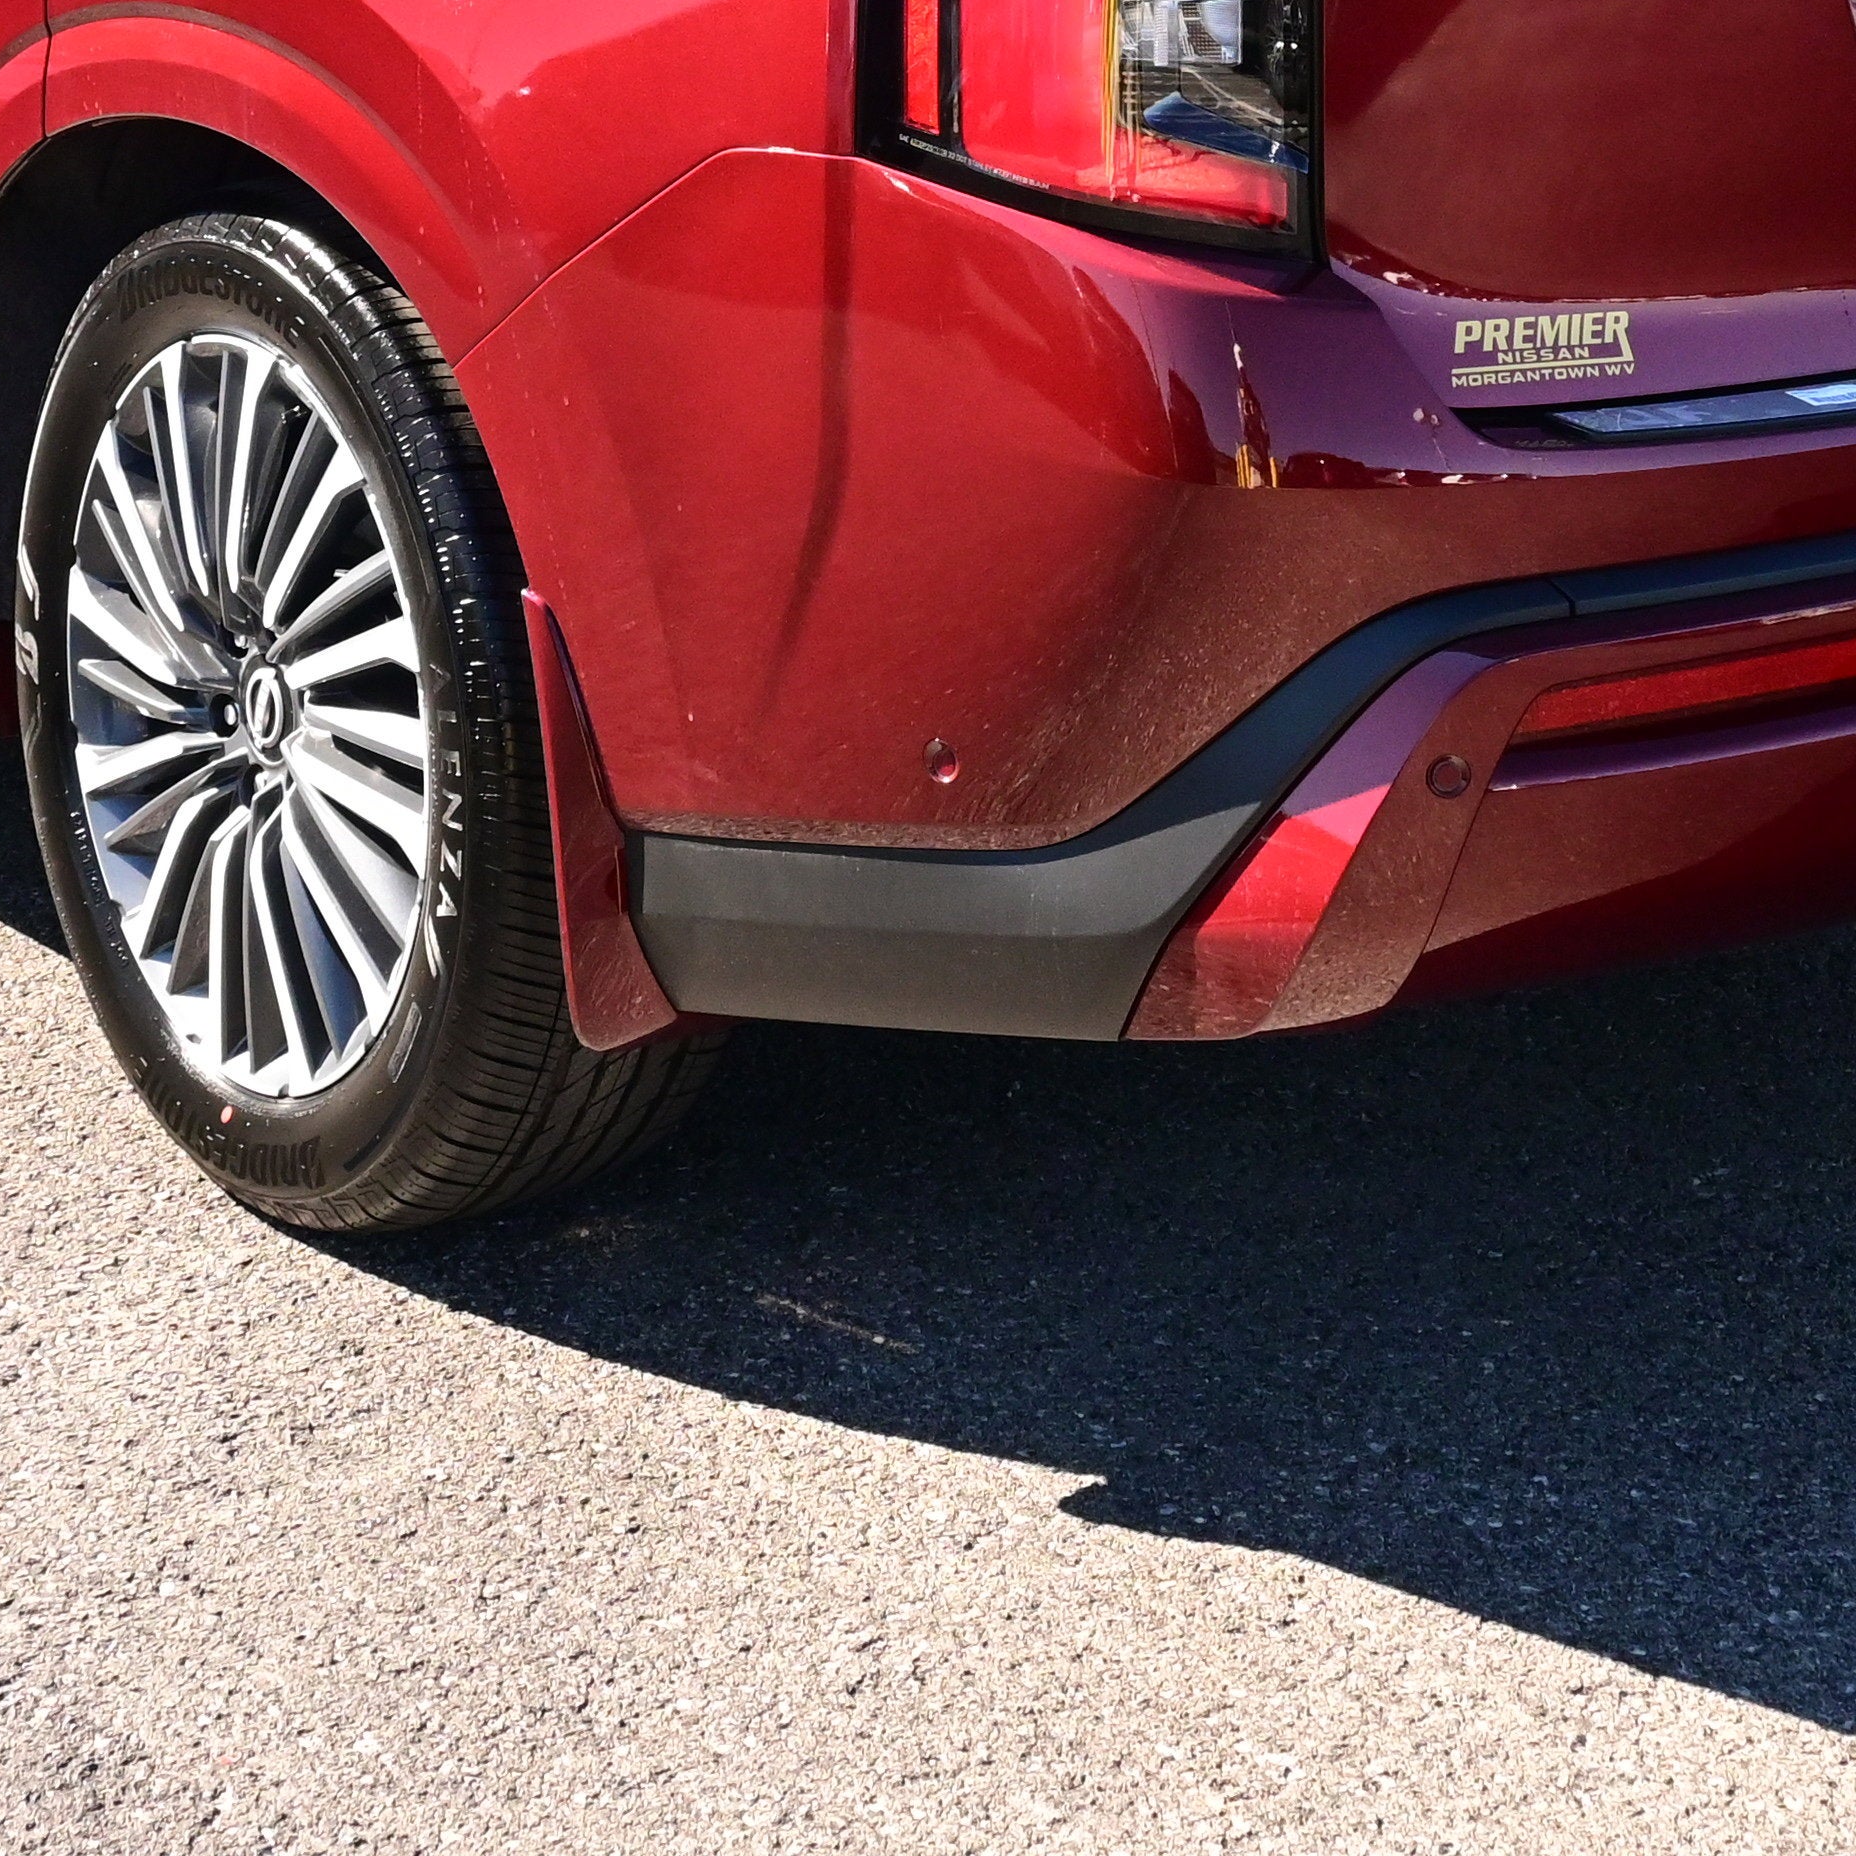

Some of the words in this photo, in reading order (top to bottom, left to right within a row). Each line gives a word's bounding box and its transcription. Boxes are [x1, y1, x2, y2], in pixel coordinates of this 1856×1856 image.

[1453, 310, 1632, 354] PREMIER
[1497, 346, 1590, 364] NISSAN
[1451, 366, 1600, 388] MORGANTOWN
[1604, 362, 1635, 376] WV
[429, 662, 463, 918] ALENZA
